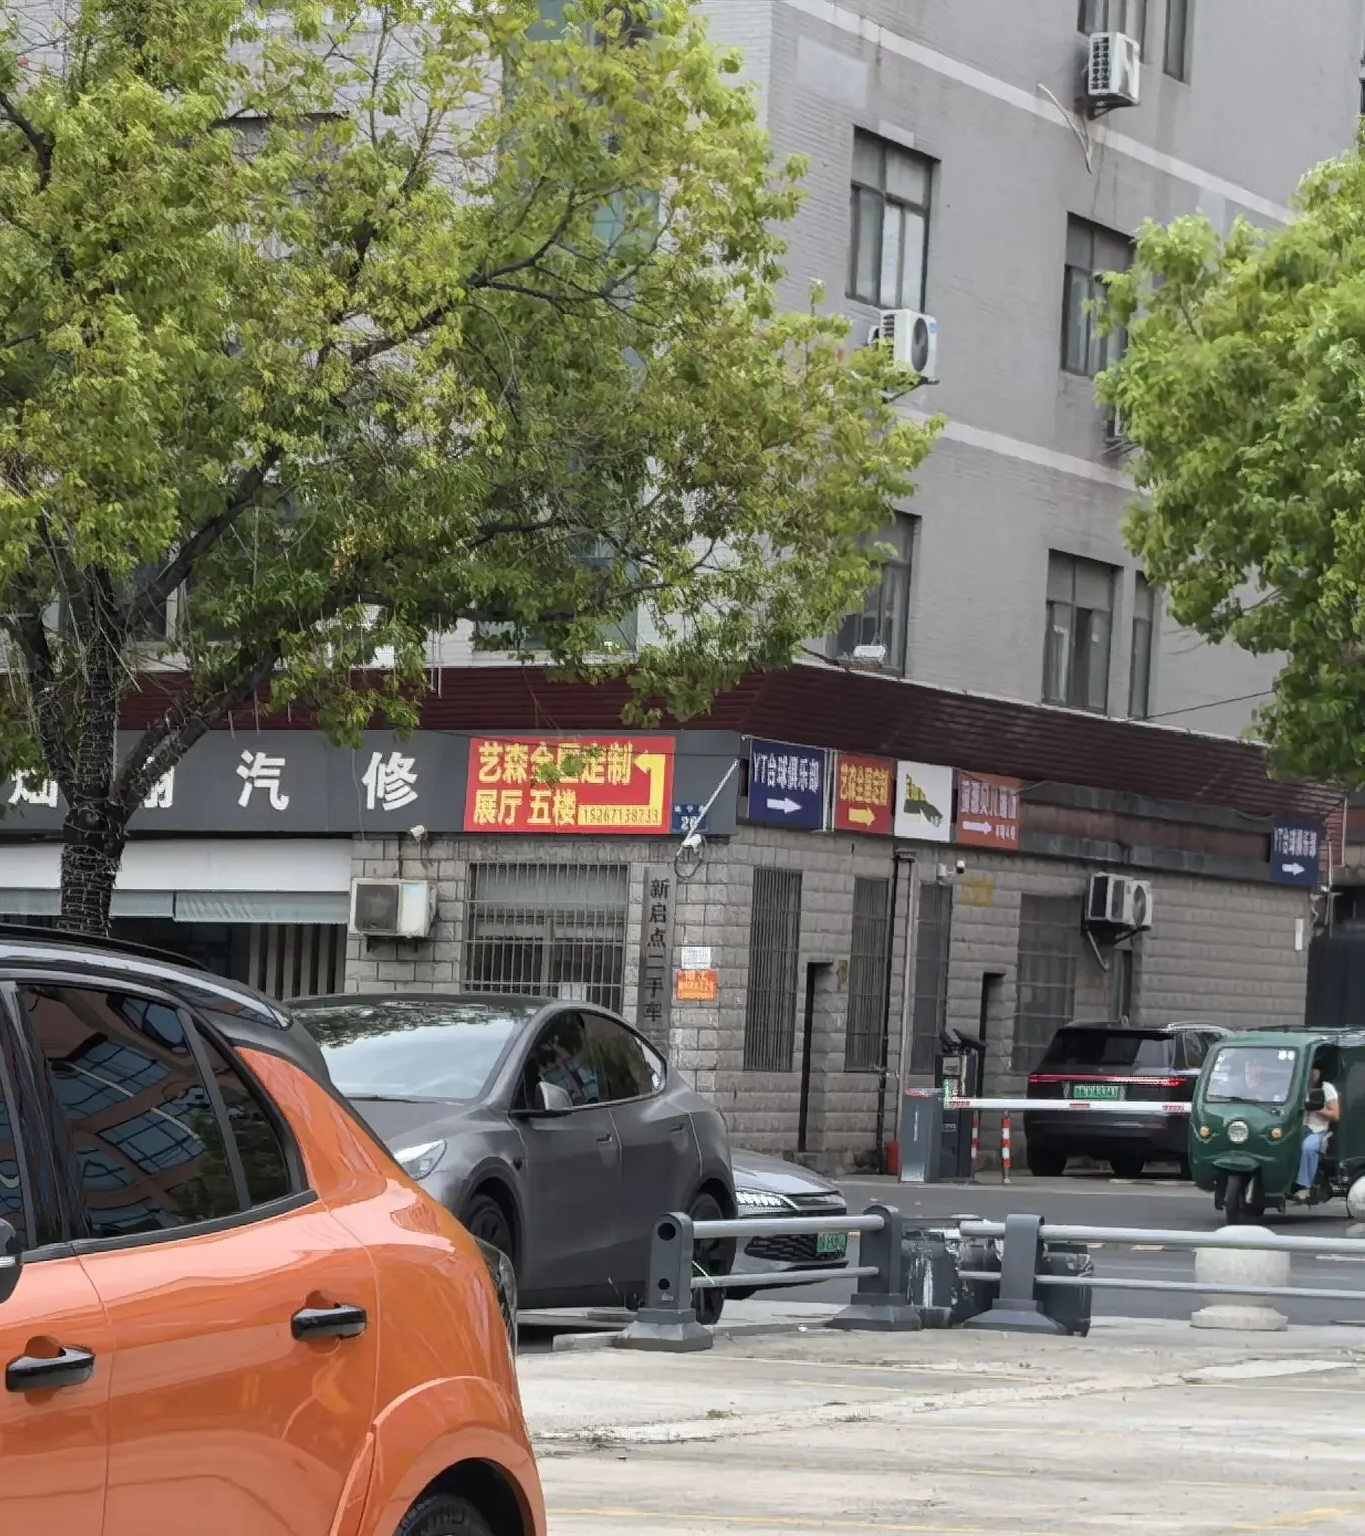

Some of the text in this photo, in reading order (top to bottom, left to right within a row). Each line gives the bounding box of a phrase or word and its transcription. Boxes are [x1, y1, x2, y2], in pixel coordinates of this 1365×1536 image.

[473, 788, 577, 825] 展厅 五楼
[643, 877, 671, 1022] 新启点二手车
